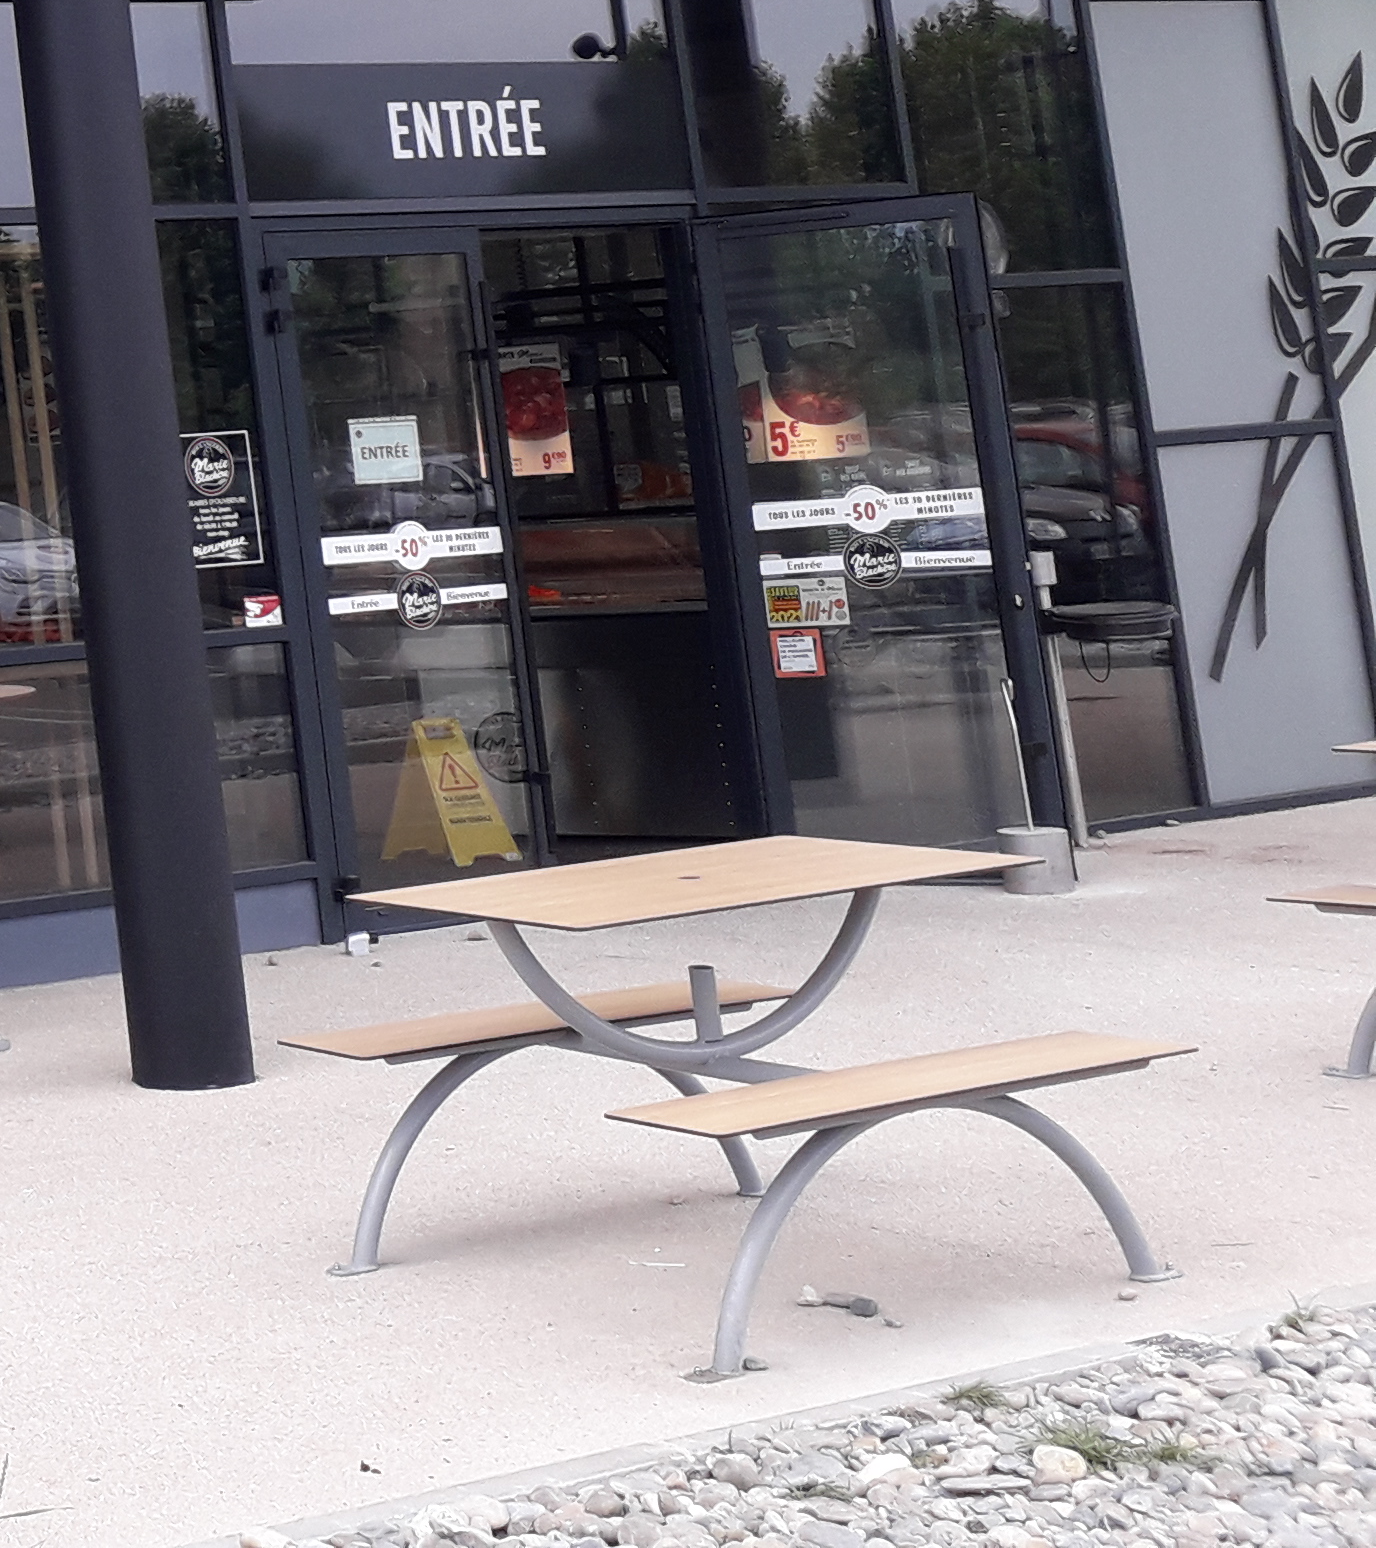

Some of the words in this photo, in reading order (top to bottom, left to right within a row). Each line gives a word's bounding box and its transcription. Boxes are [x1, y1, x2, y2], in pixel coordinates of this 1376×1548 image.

[386, 85, 547, 159] ENTRÉE
[360, 442, 409, 460] ENTRÉE
[787, 559, 823, 571] Entrée
[850, 553, 897, 569] Marie
[914, 554, 976, 567] Bienvenue
[351, 599, 380, 610] Entrée
